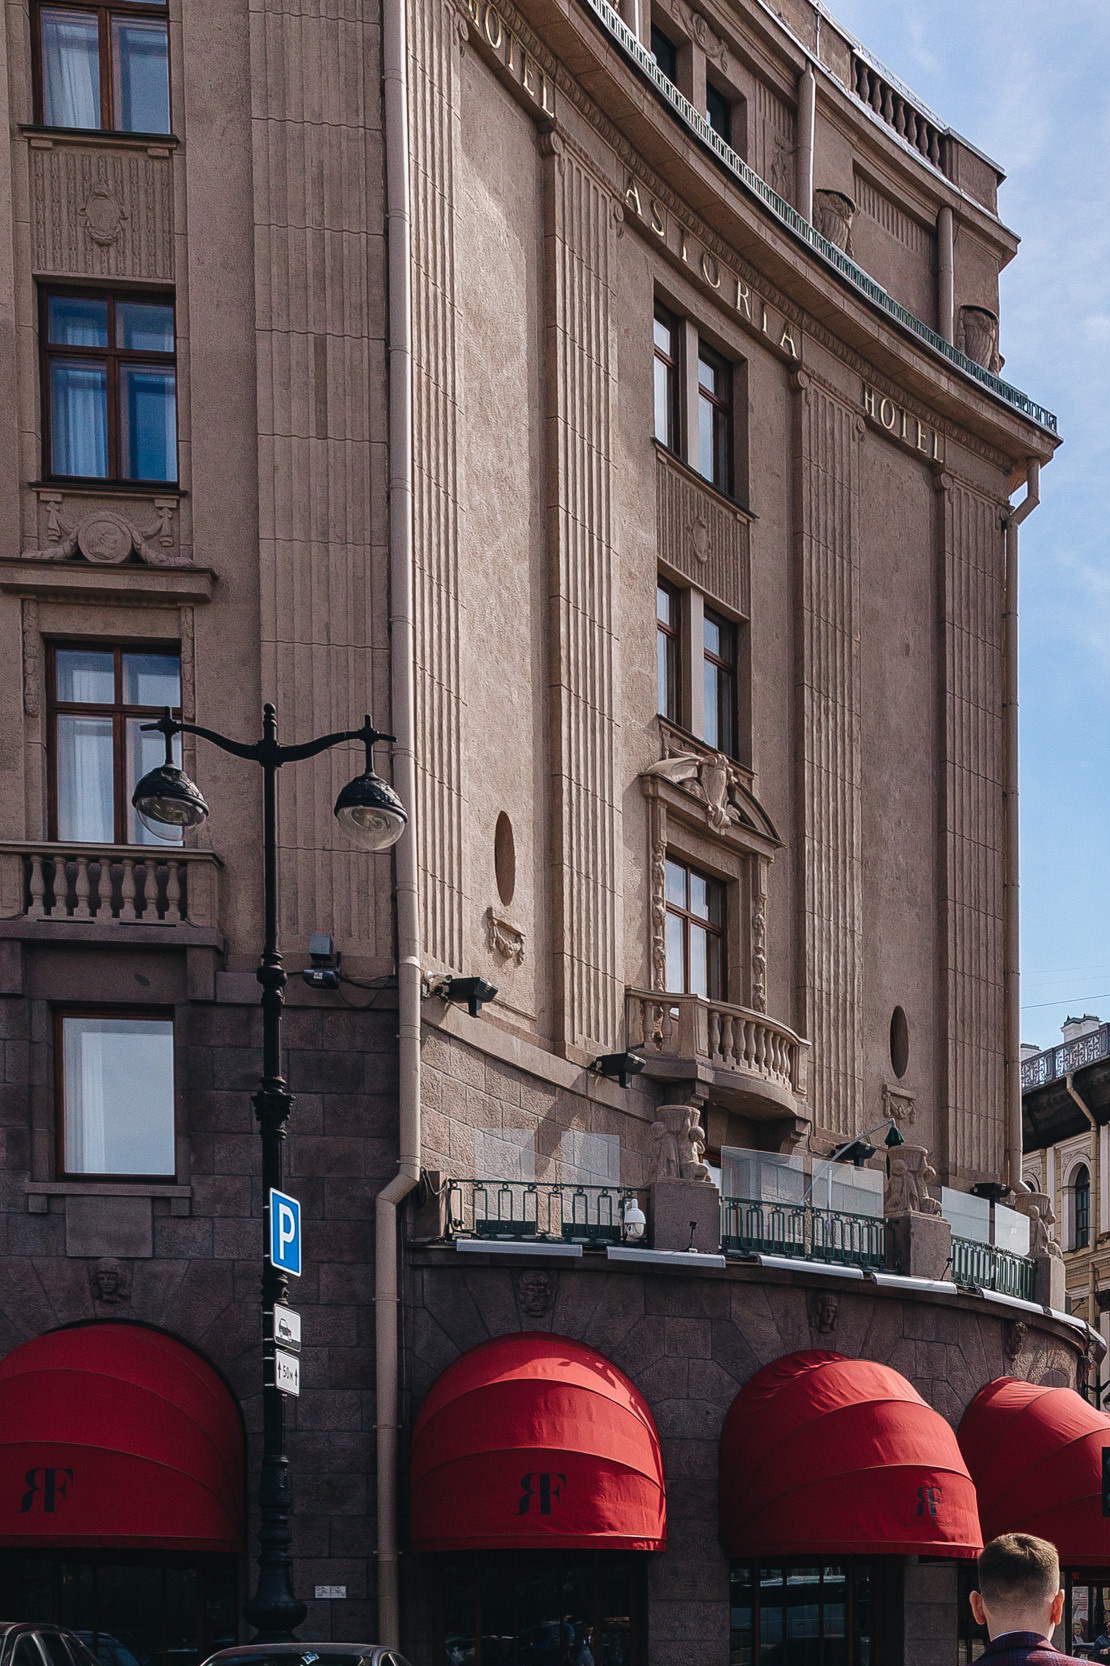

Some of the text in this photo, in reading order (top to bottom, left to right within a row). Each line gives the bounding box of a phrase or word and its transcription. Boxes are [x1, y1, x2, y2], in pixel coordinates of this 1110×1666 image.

[626, 180, 798, 360] ASTORIA
[864, 383, 944, 463] HOTEL
[279, 1203, 295, 1260] P
